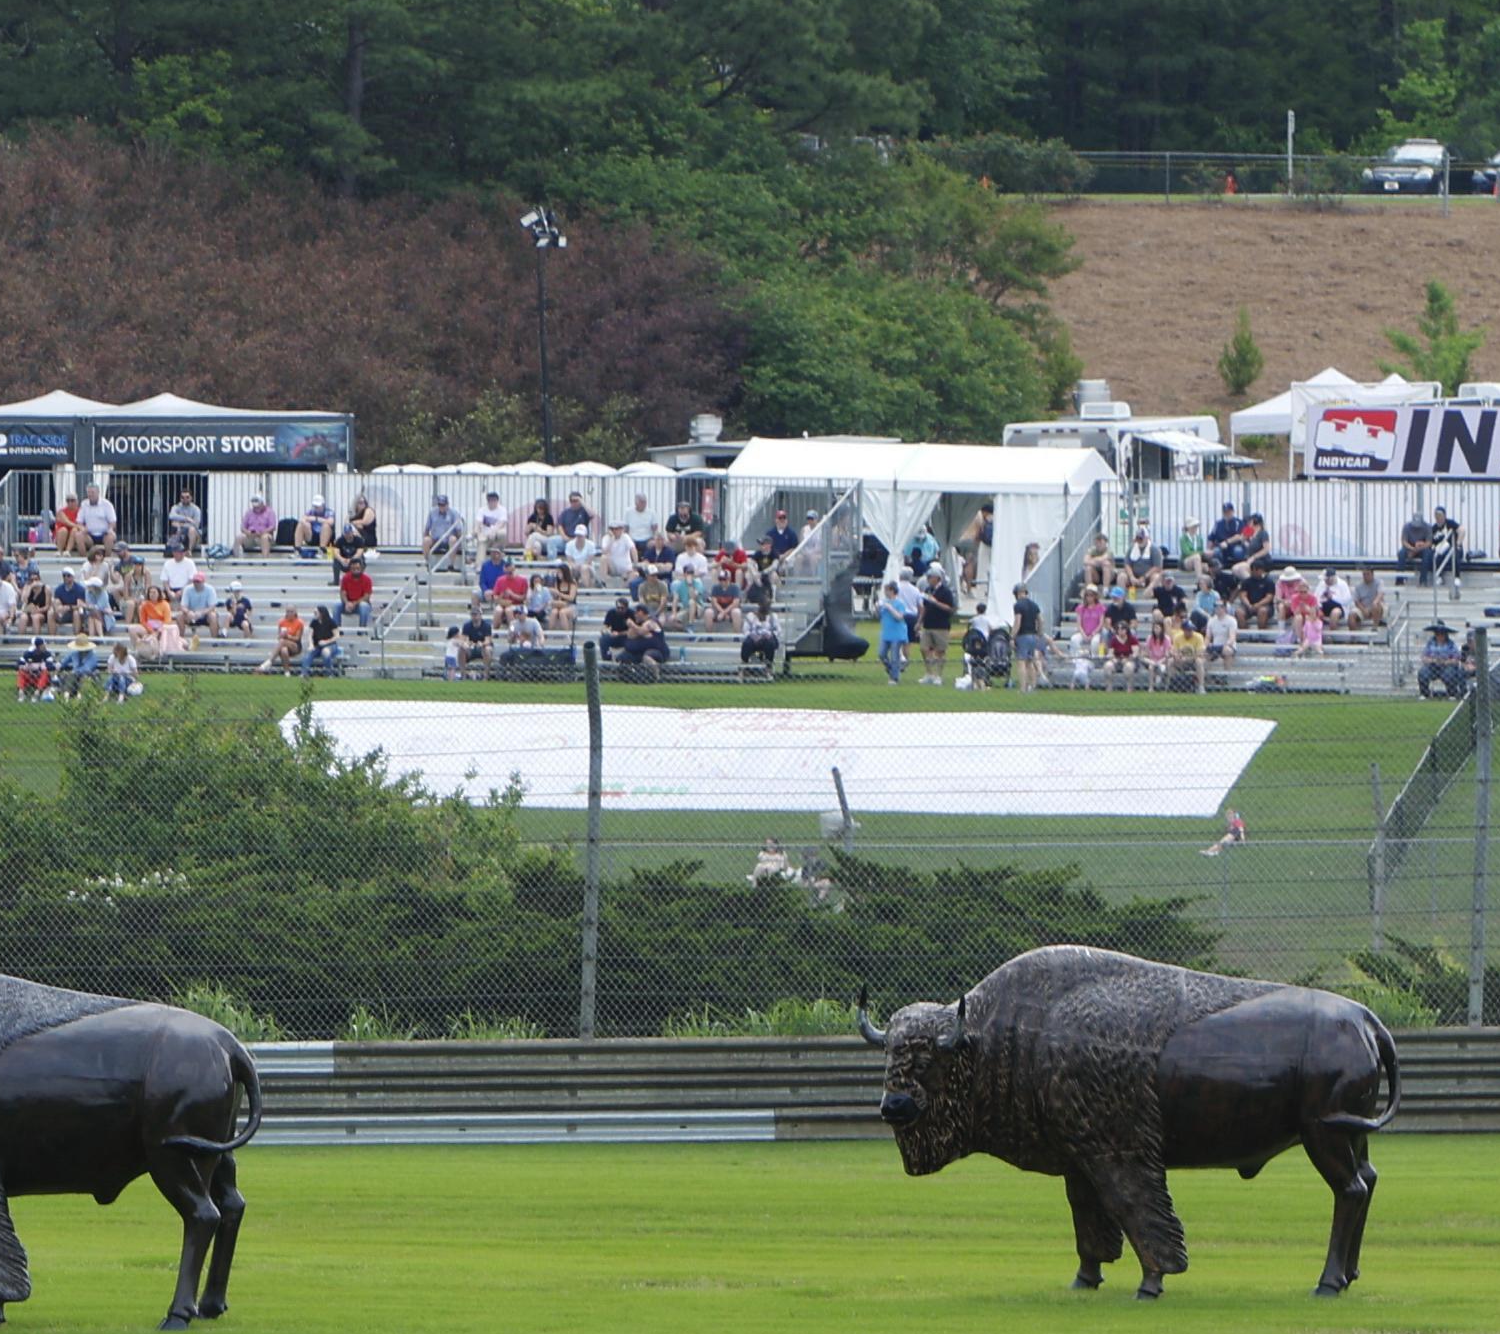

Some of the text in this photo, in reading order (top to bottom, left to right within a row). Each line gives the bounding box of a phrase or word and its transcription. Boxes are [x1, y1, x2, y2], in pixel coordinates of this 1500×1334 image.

[9, 434, 68, 446] TRACKSIDE
[101, 434, 276, 455] MOTORSPORT STORE
[9, 446, 68, 455] INTERNATIONAL
[1317, 455, 1370, 468] INDYCAR
